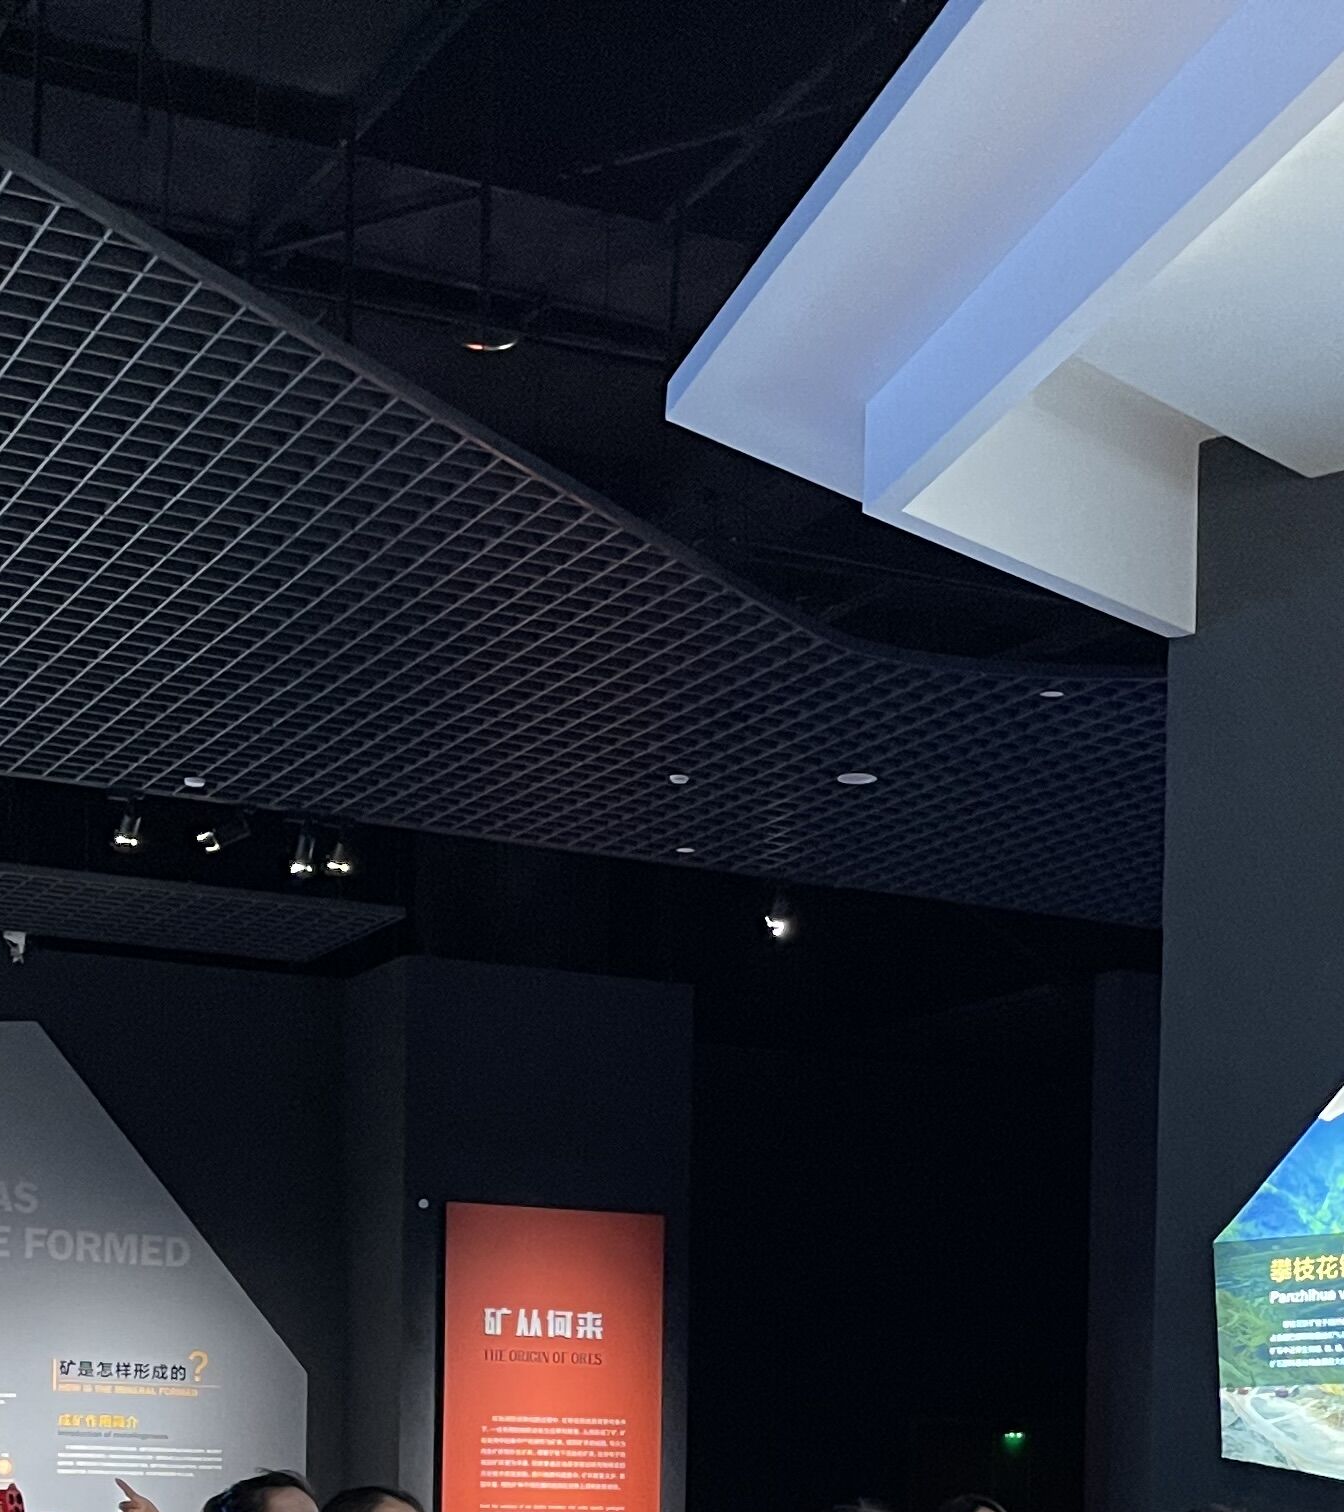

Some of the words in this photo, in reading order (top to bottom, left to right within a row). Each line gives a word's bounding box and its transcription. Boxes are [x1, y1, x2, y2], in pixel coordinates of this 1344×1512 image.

[24, 1227, 191, 1267] FORMED
[483, 1307, 604, 1340] 矿从何来
